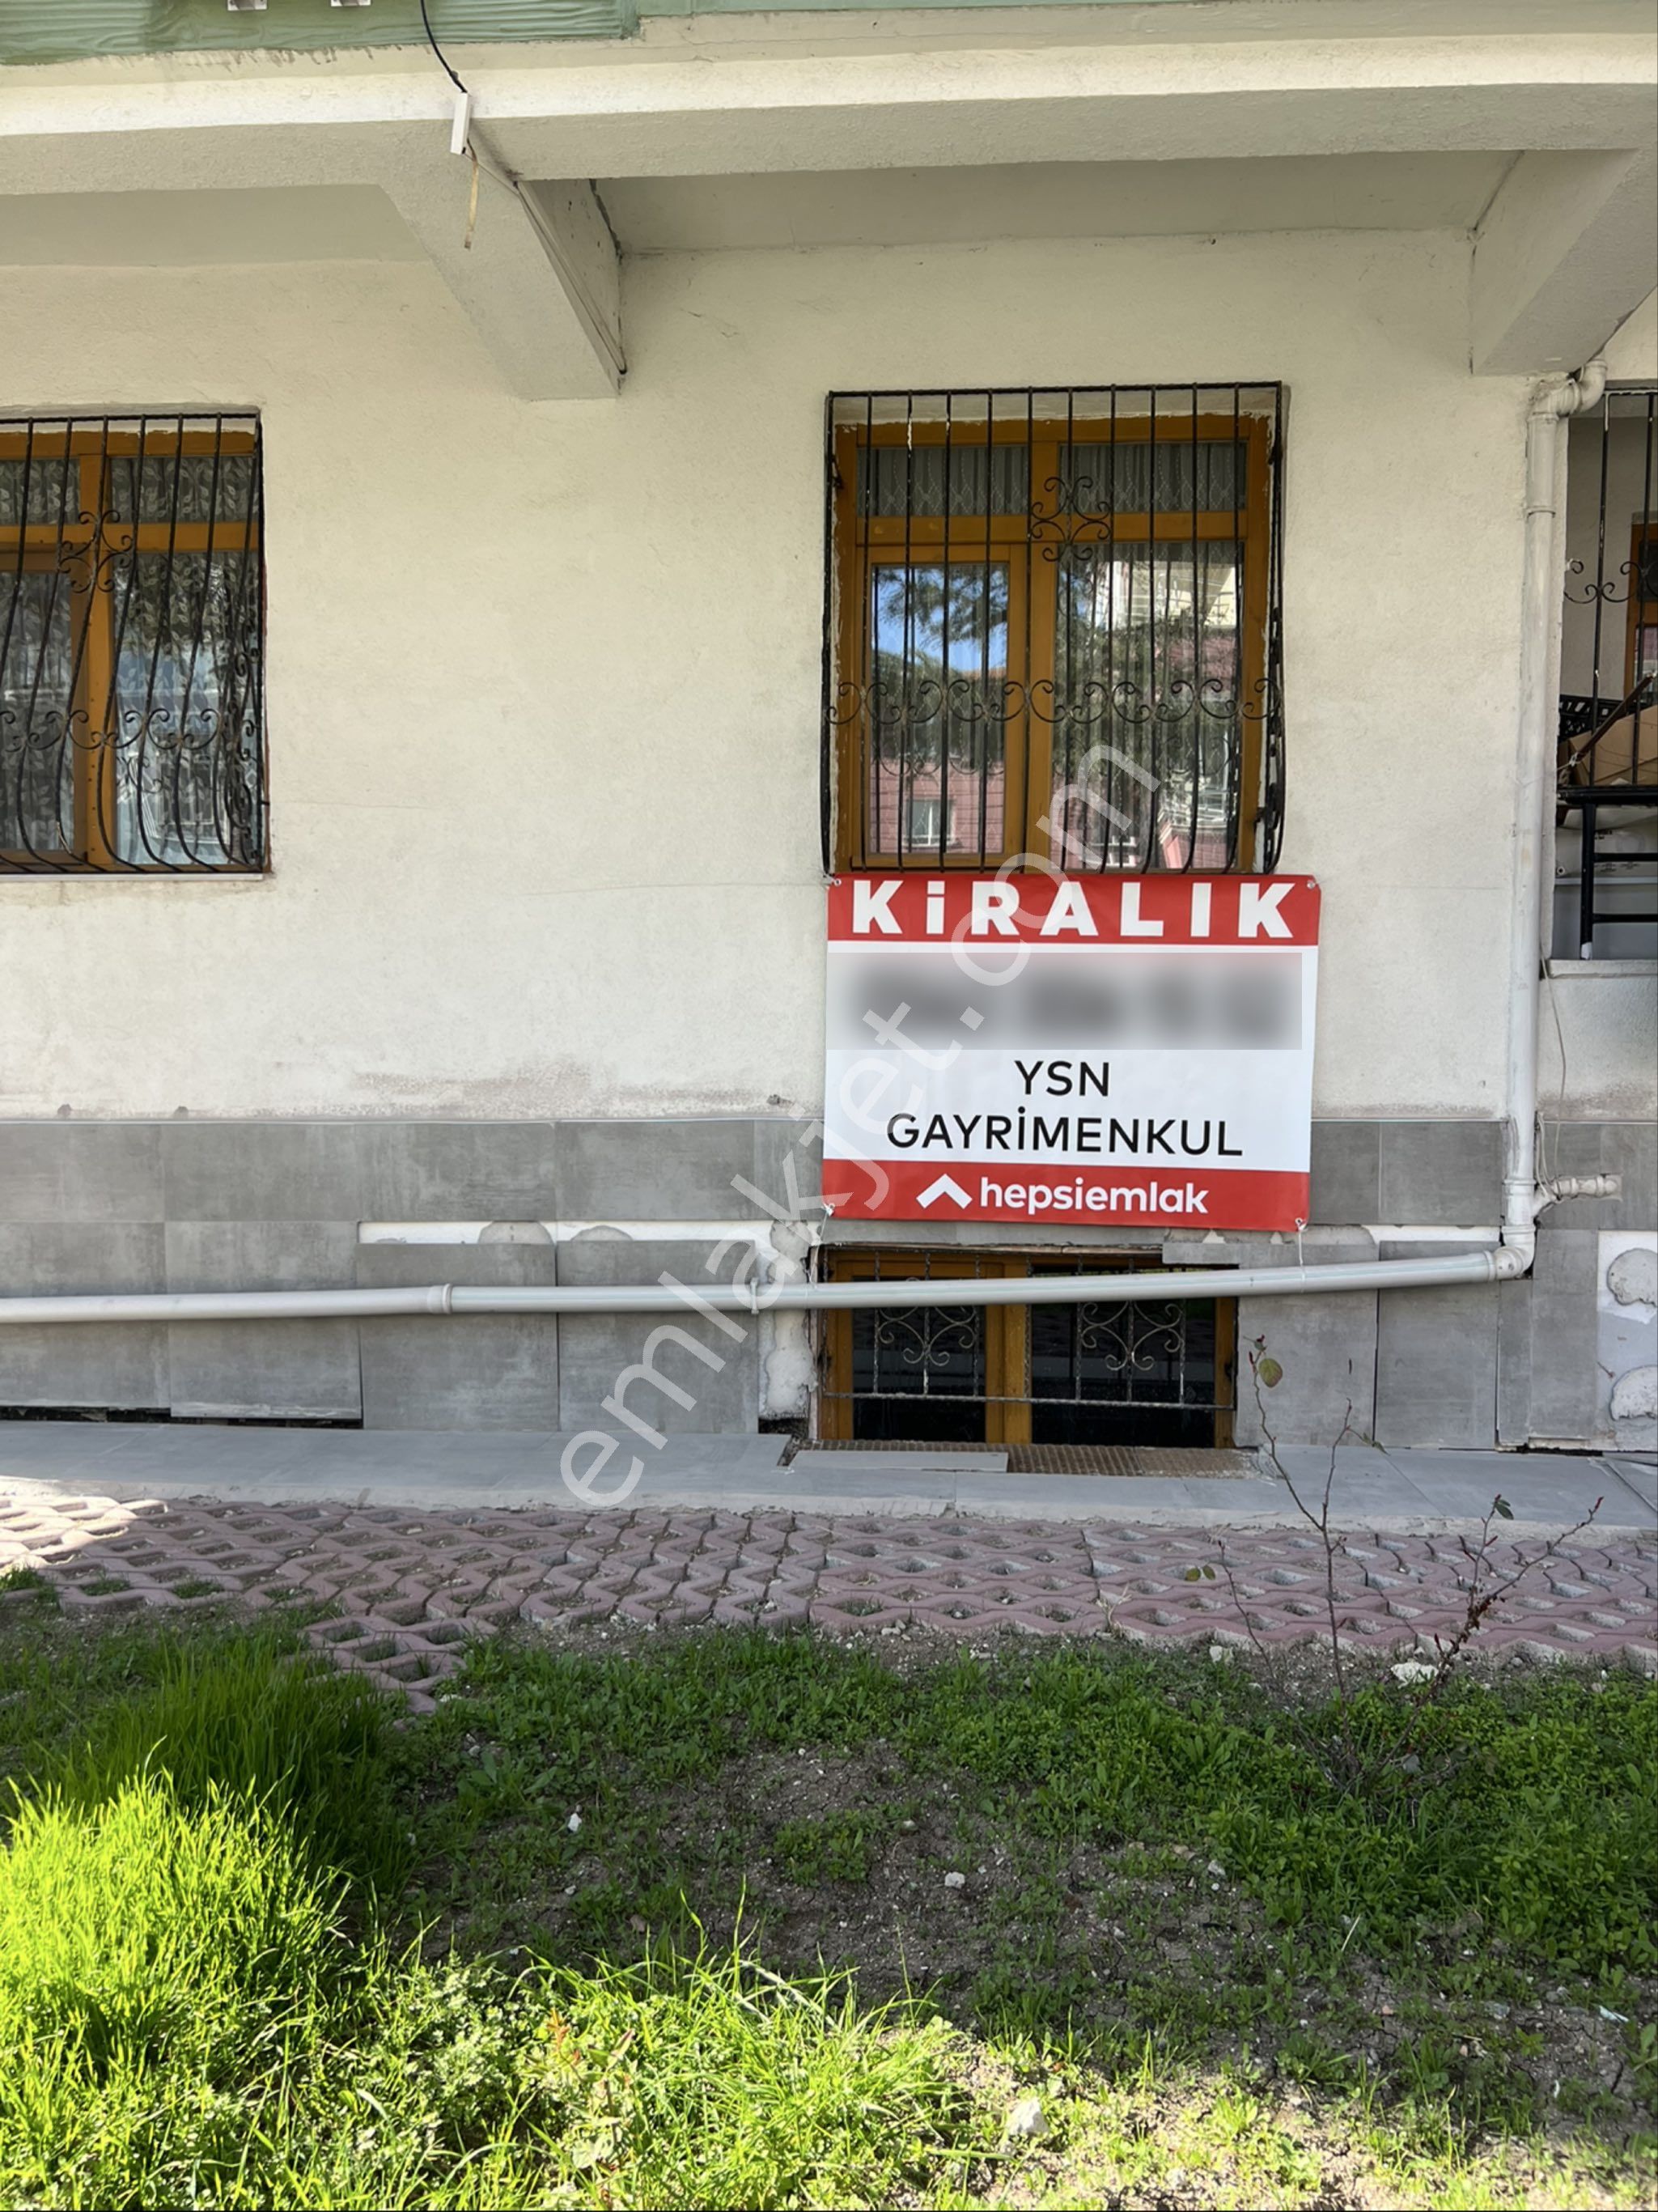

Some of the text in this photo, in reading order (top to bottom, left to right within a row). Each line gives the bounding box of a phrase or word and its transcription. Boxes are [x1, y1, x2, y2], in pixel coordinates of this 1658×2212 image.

[1015, 1060, 1109, 1097] YSN
[887, 1106, 1242, 1156] GAYRİMENKUL
[981, 1177, 1208, 1214] hepsiemlak
